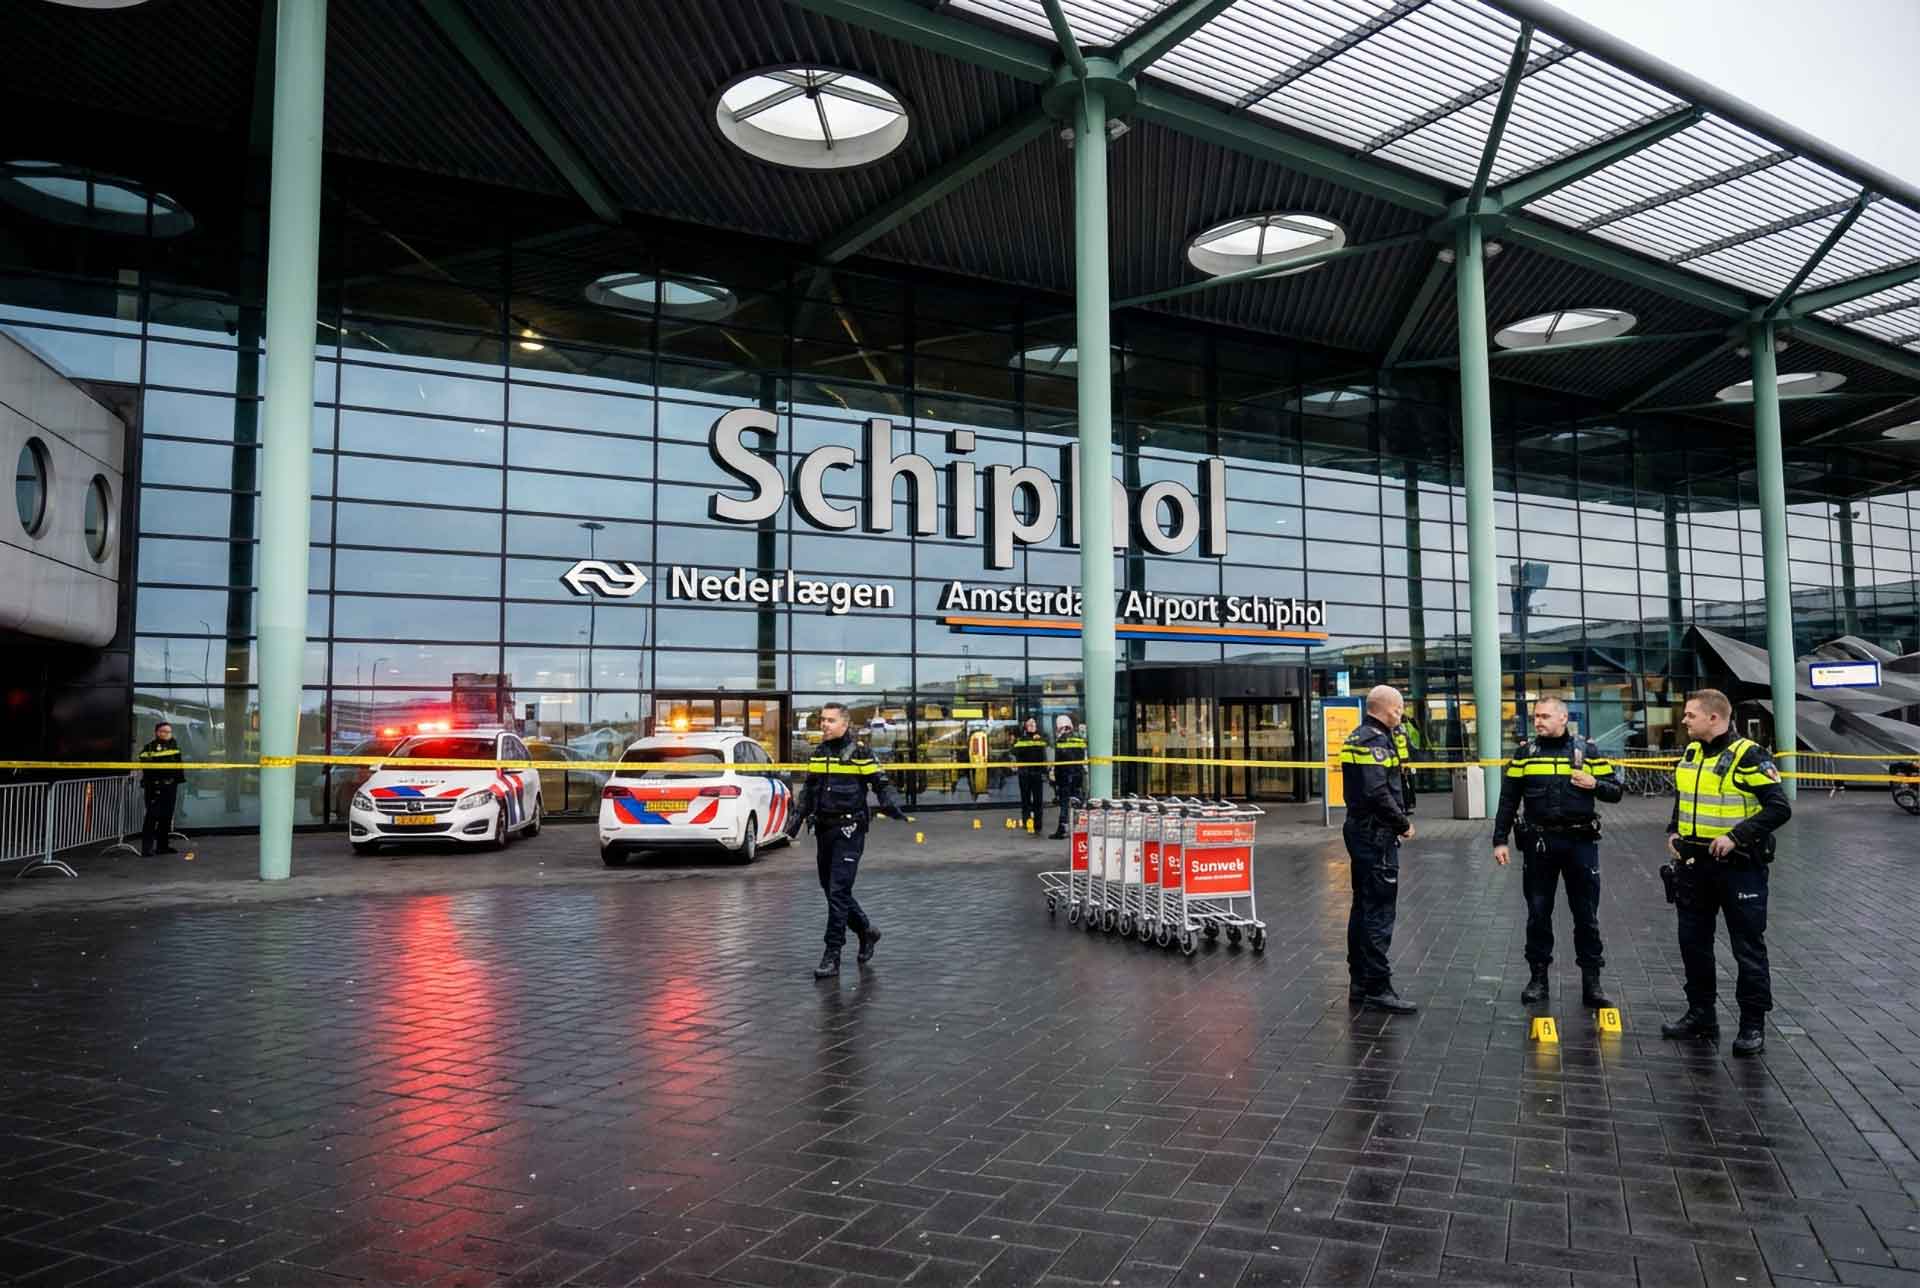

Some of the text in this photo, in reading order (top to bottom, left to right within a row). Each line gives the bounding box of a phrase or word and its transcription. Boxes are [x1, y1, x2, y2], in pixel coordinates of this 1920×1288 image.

[945, 581, 1327, 631] Amsterda Airport Schiphol
